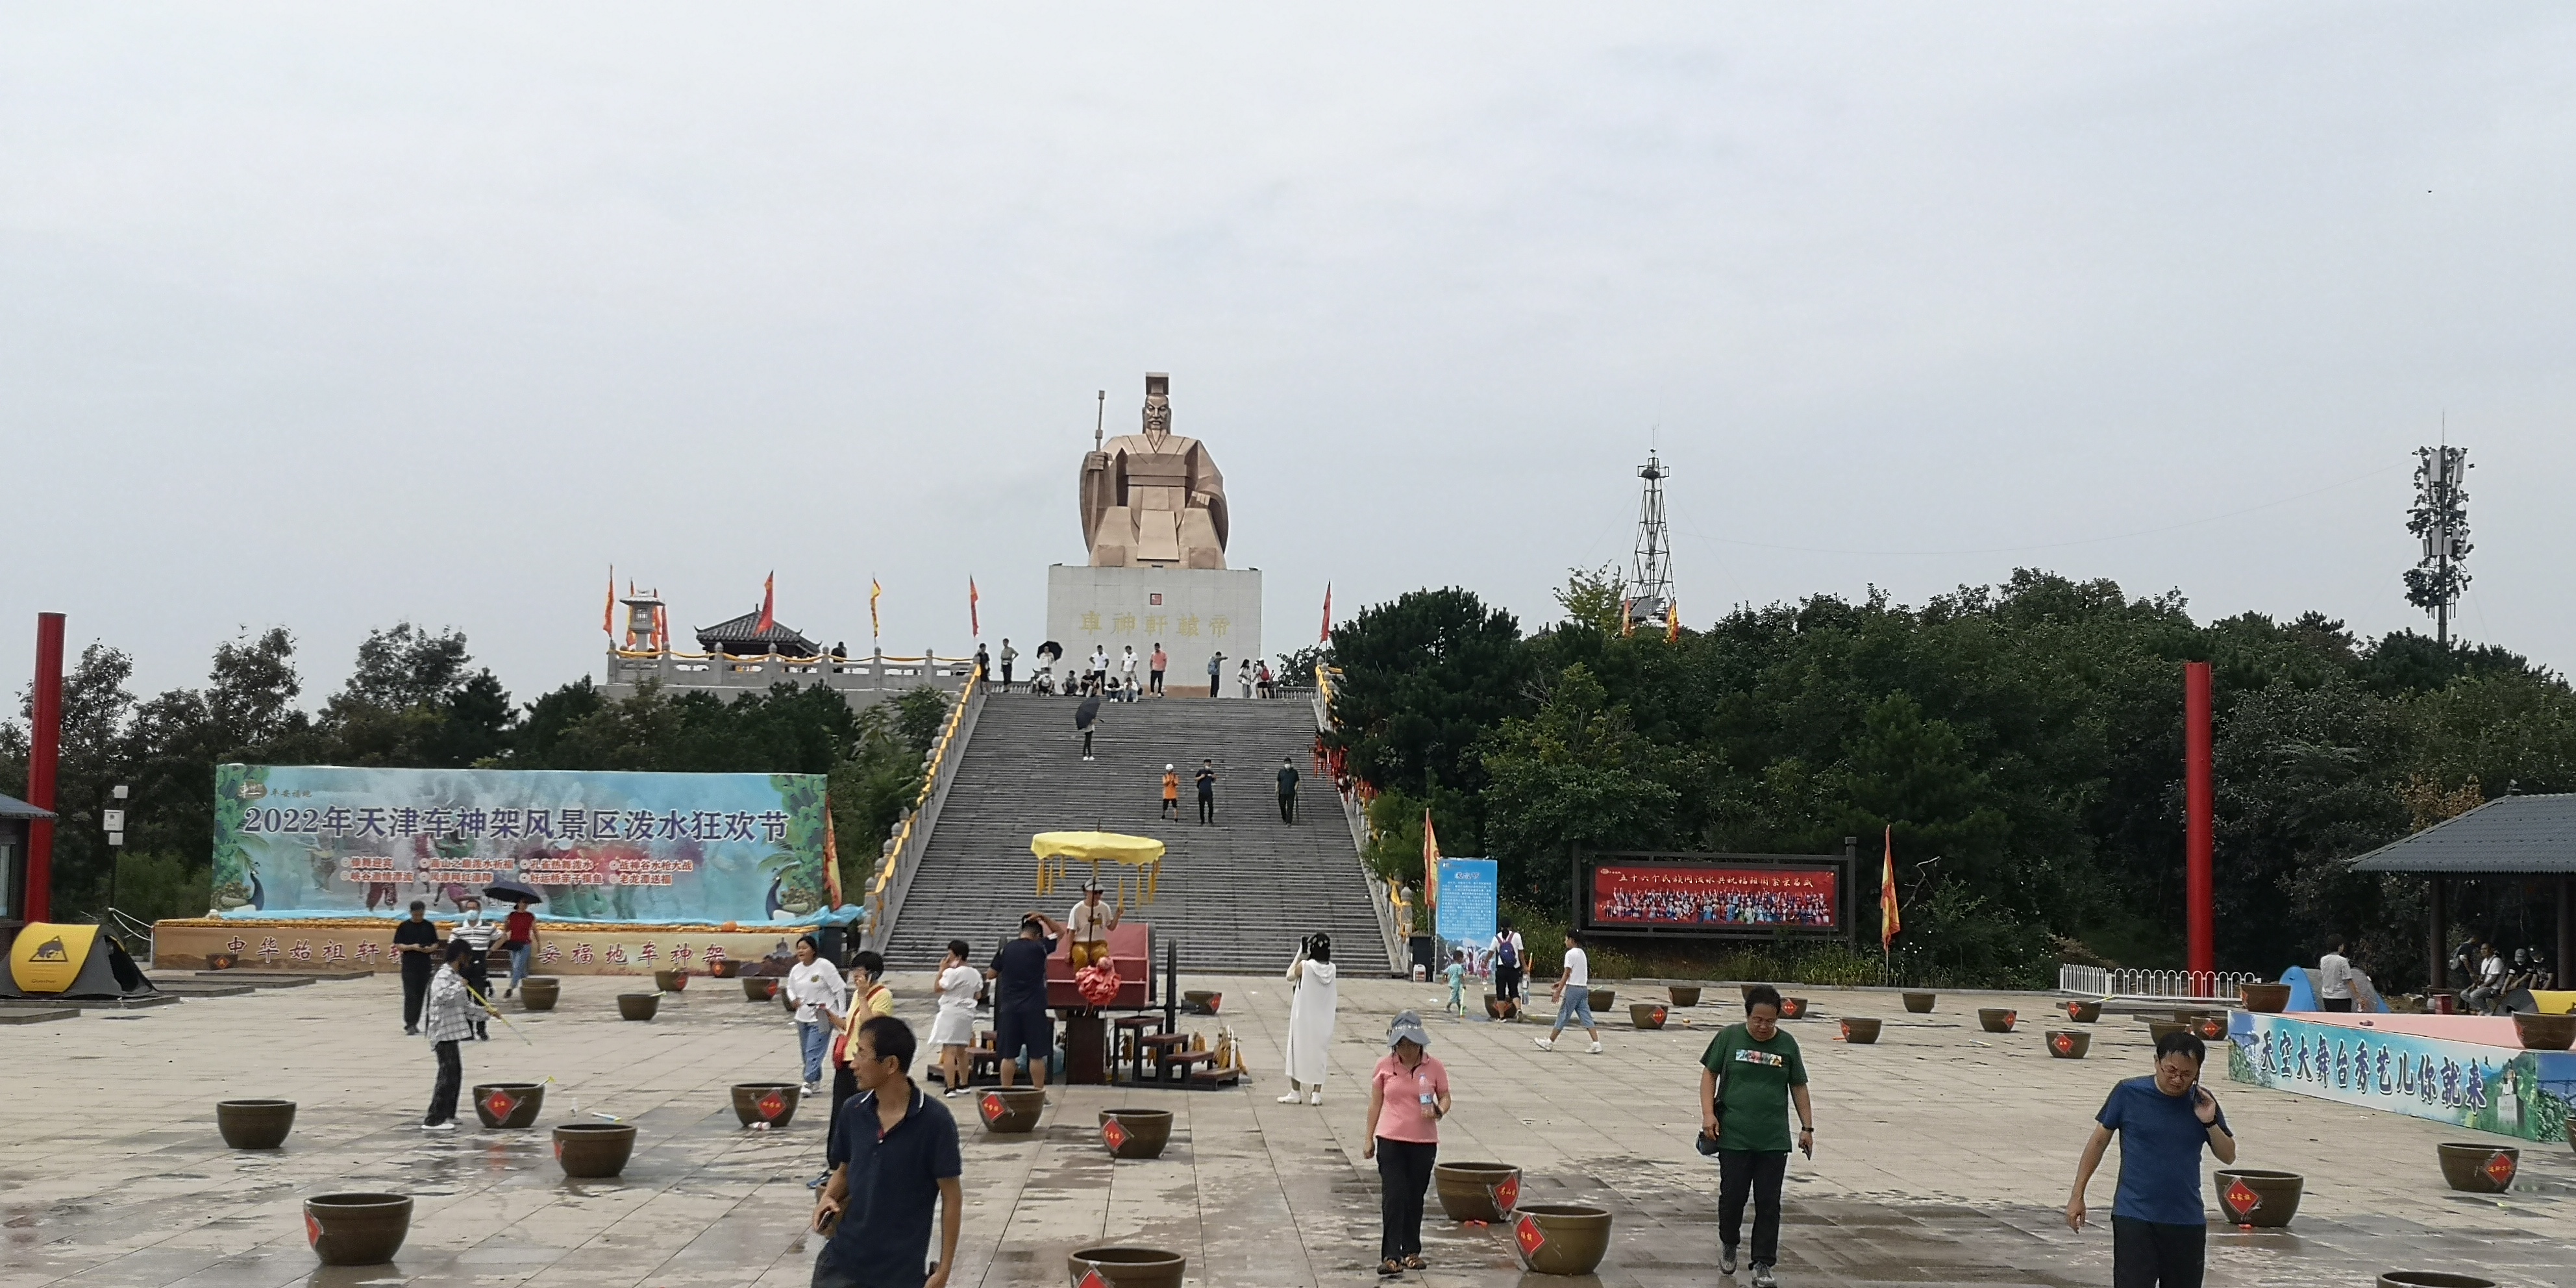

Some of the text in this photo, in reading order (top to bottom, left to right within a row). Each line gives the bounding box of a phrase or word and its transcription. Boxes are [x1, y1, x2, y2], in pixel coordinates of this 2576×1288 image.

[243, 804, 790, 843] 2022年天津车神架风景区泼水狂欢节
[529, 859, 595, 871] 孔雀热舞泼水
[619, 860, 693, 872] 战神谷水枪大战
[528, 873, 604, 885] 好运桥亲子摸鱼
[619, 874, 673, 886] 老龙潭送福
[2261, 1029, 2488, 1115] 天空大舞台秀艺儿你就来
